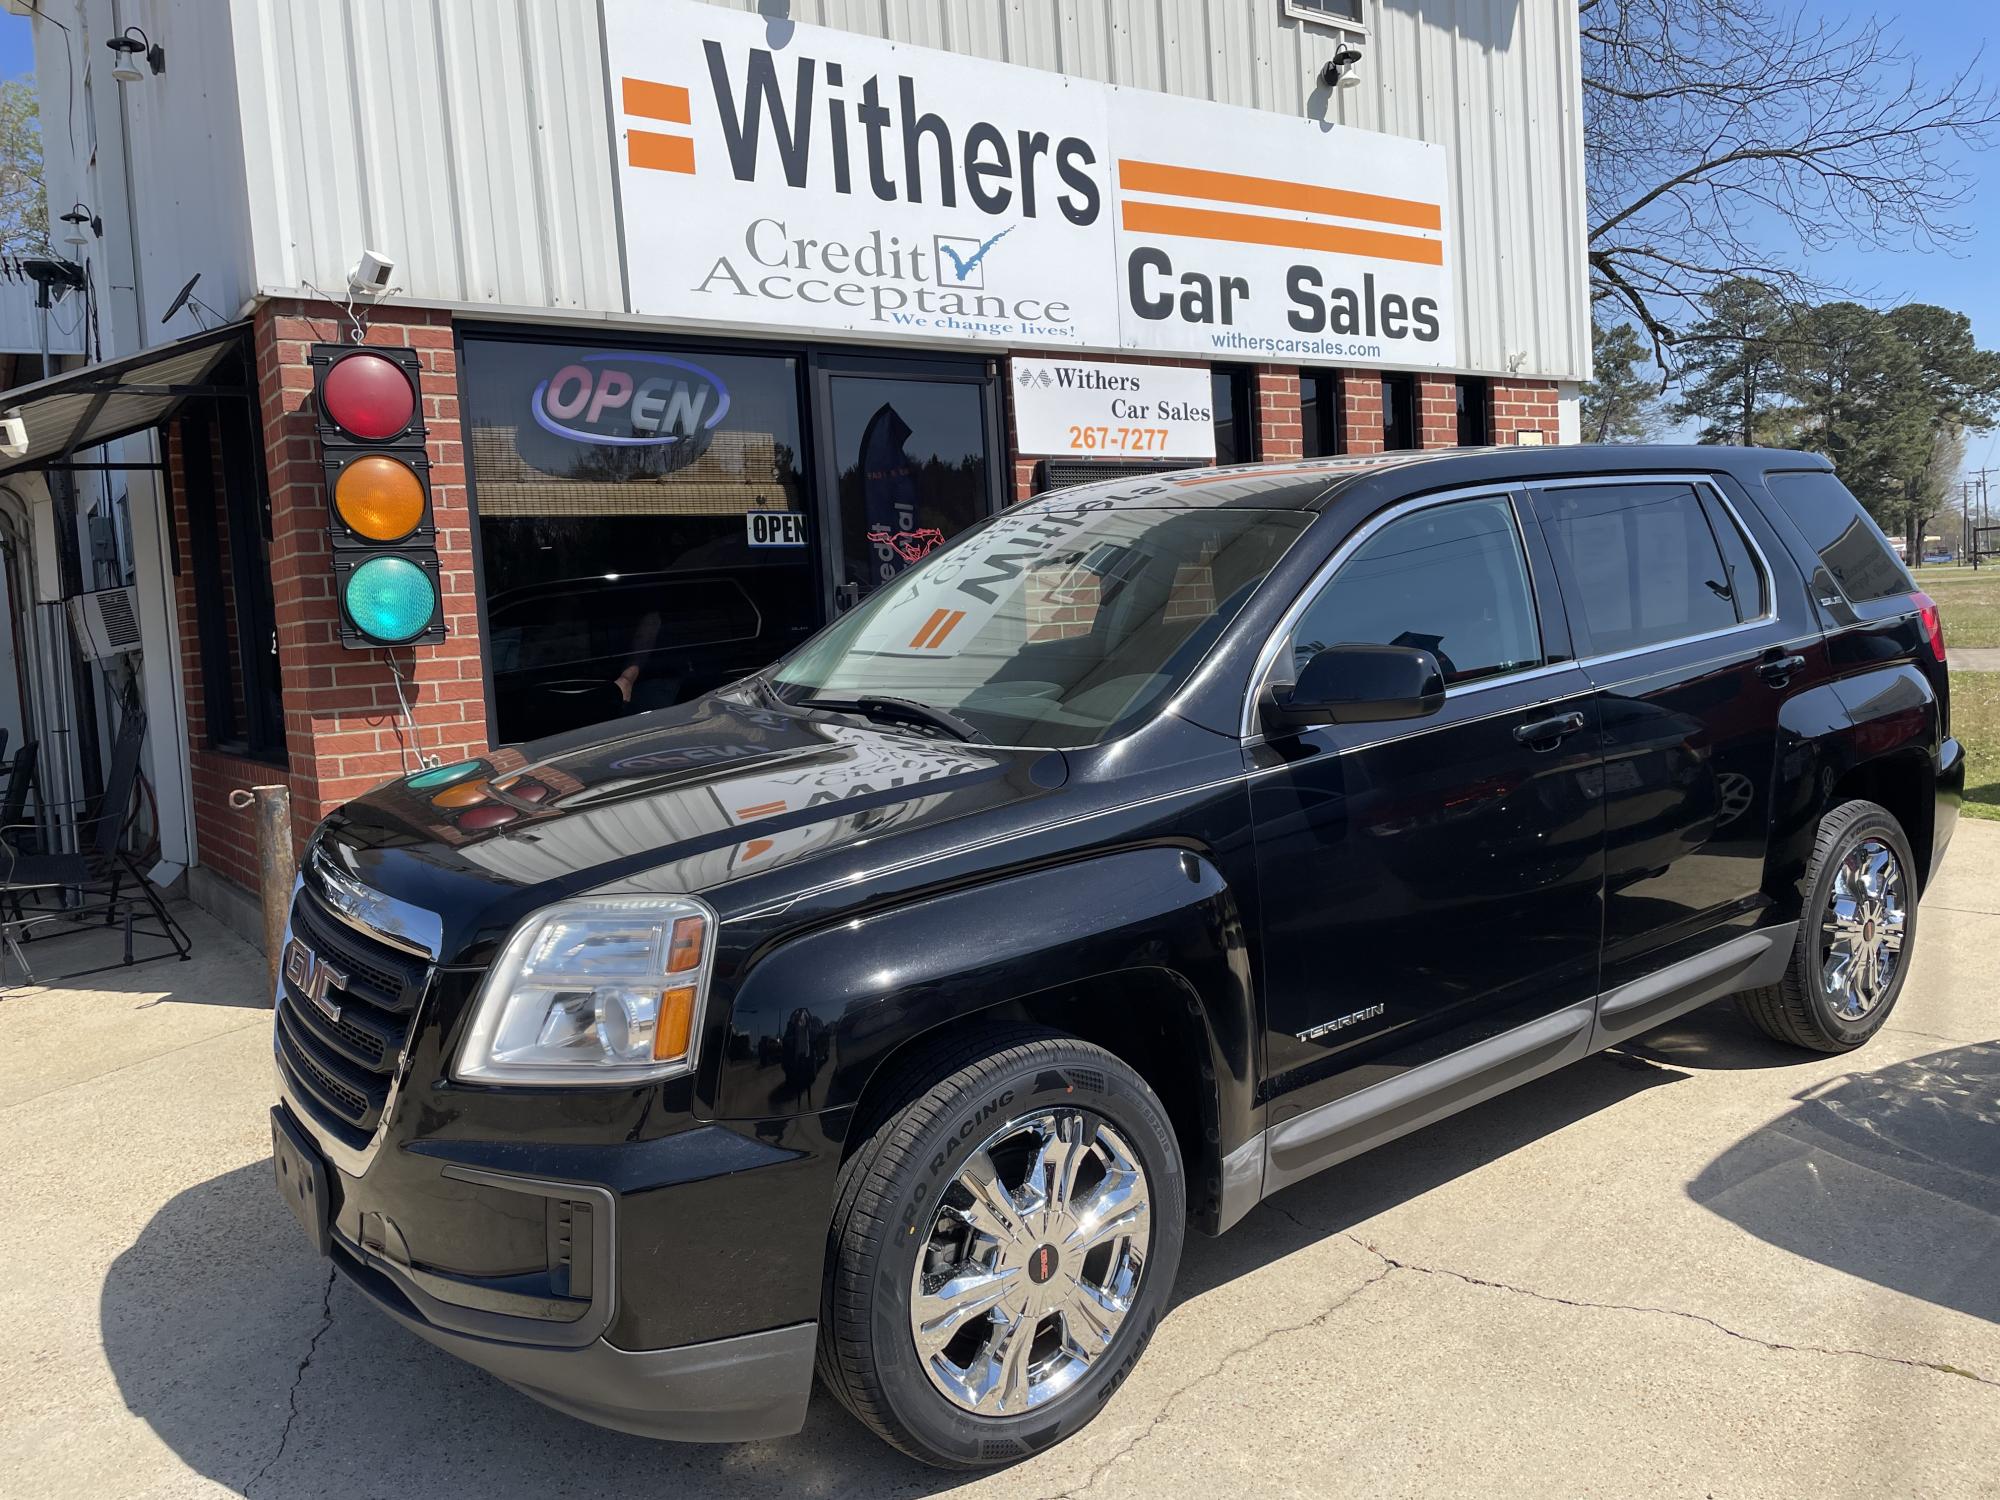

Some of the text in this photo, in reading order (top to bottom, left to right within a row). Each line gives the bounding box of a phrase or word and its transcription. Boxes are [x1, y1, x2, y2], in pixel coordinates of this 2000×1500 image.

[702, 39, 1100, 227] Withers
[745, 218, 929, 282] Credit
[691, 256, 1071, 323] Acceptance
[1127, 246, 1440, 343] Car Sales
[891, 311, 1076, 338] We change lives!
[1211, 331, 1382, 359] witherscarsales.com
[547, 365, 711, 436] OPEN
[1055, 367, 1141, 392] Withers
[1111, 399, 1211, 423] Car Sales
[1069, 425, 1169, 452] 267-7277
[753, 514, 808, 544] OPEN
[286, 936, 349, 1022] GMC
[1296, 1003, 1384, 1043] TERRAIN
[894, 1088, 1016, 1248] PRO RACING
